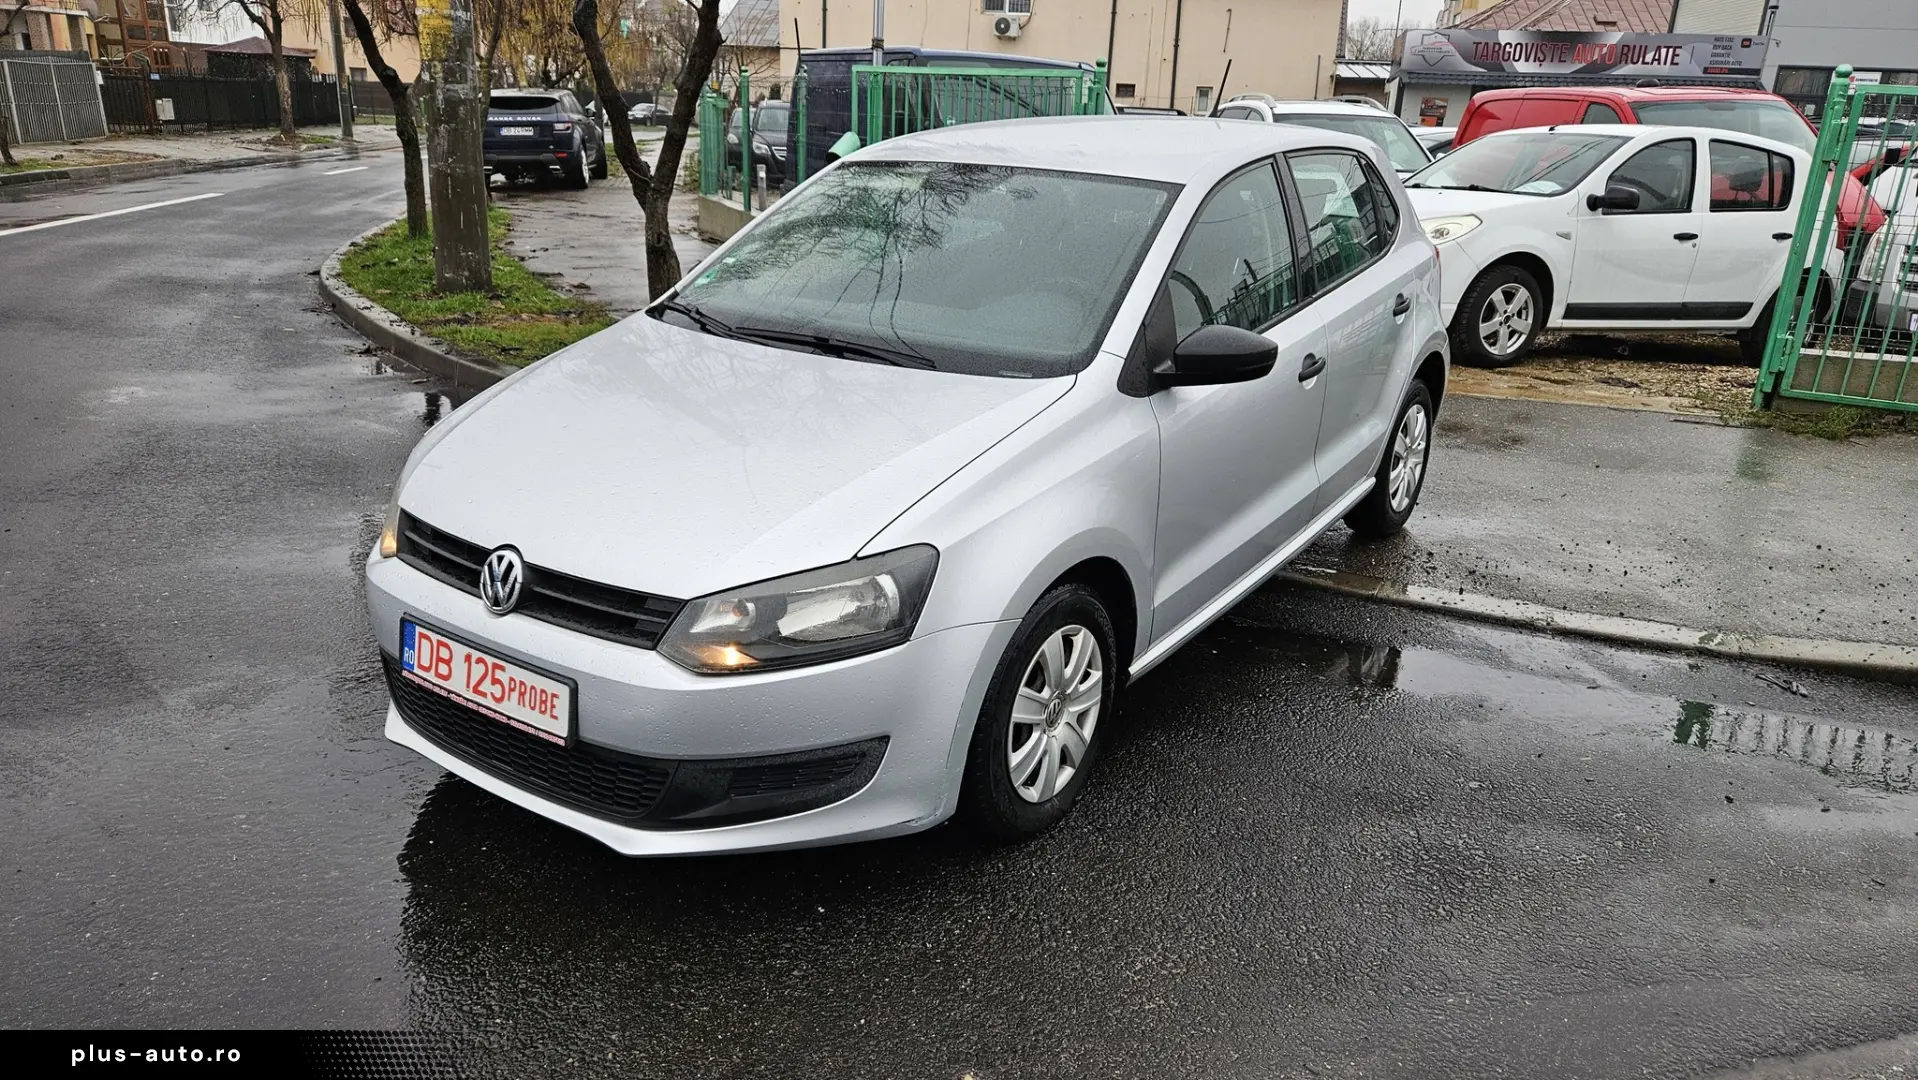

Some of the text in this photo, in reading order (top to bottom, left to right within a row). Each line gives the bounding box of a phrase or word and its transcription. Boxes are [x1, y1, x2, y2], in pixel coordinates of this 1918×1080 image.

[1472, 41, 1683, 68] TARGOVIȘTE AUTO RULATE
[403, 646, 415, 665] RO
[416, 631, 453, 682] DB
[464, 652, 506, 704] 125
[507, 676, 560, 721] PROBE
